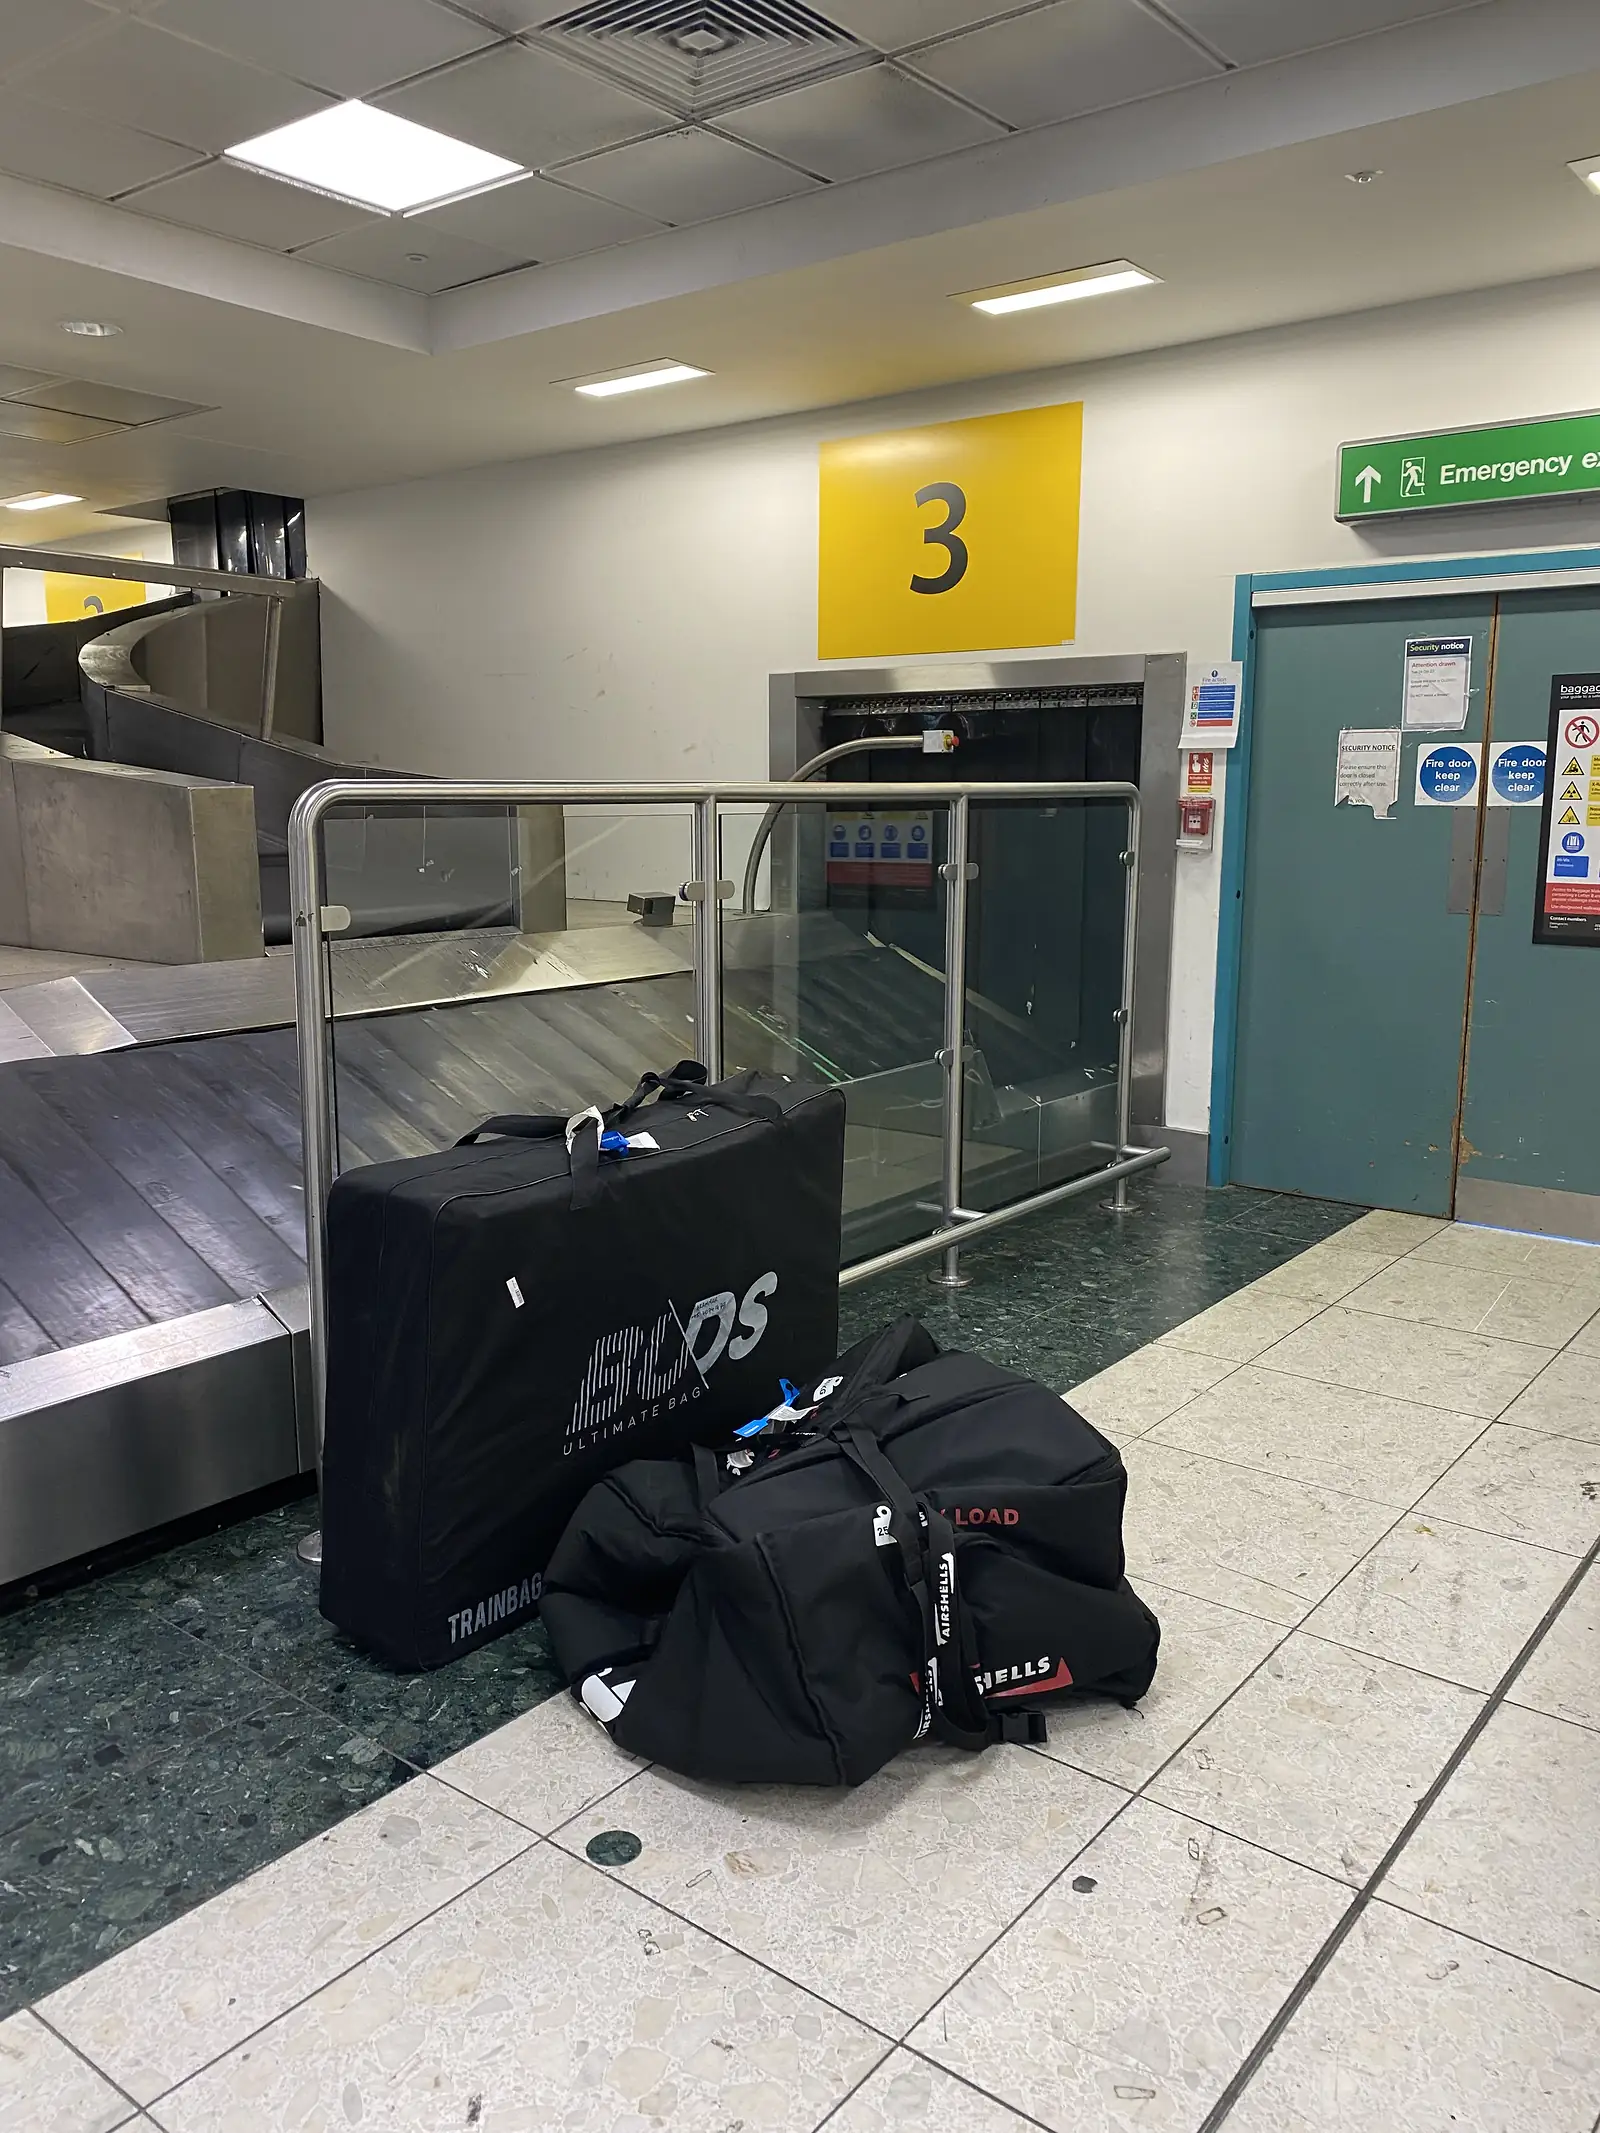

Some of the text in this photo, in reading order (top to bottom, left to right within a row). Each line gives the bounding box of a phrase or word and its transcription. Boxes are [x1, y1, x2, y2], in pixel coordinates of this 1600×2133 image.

[1440, 451, 1600, 485] Emergency e
[910, 481, 969, 595] 3
[1410, 642, 1465, 652] Security notice
[1341, 744, 1371, 752] SECURITY
[1426, 758, 1472, 768] Fire door
[1498, 758, 1546, 768] Fire door
[1435, 771, 1460, 781] keep
[1508, 770, 1535, 781] keep
[1435, 783, 1460, 792] clear
[1508, 783, 1535, 792] clear
[563, 1387, 701, 1455] ULTIMATE BAG
[955, 1508, 1019, 1526] LOAD
[939, 1561, 950, 1638] AIRSHELLS
[448, 1572, 543, 1644] TRAINBAG
[975, 1657, 1050, 1695] SHELLS
